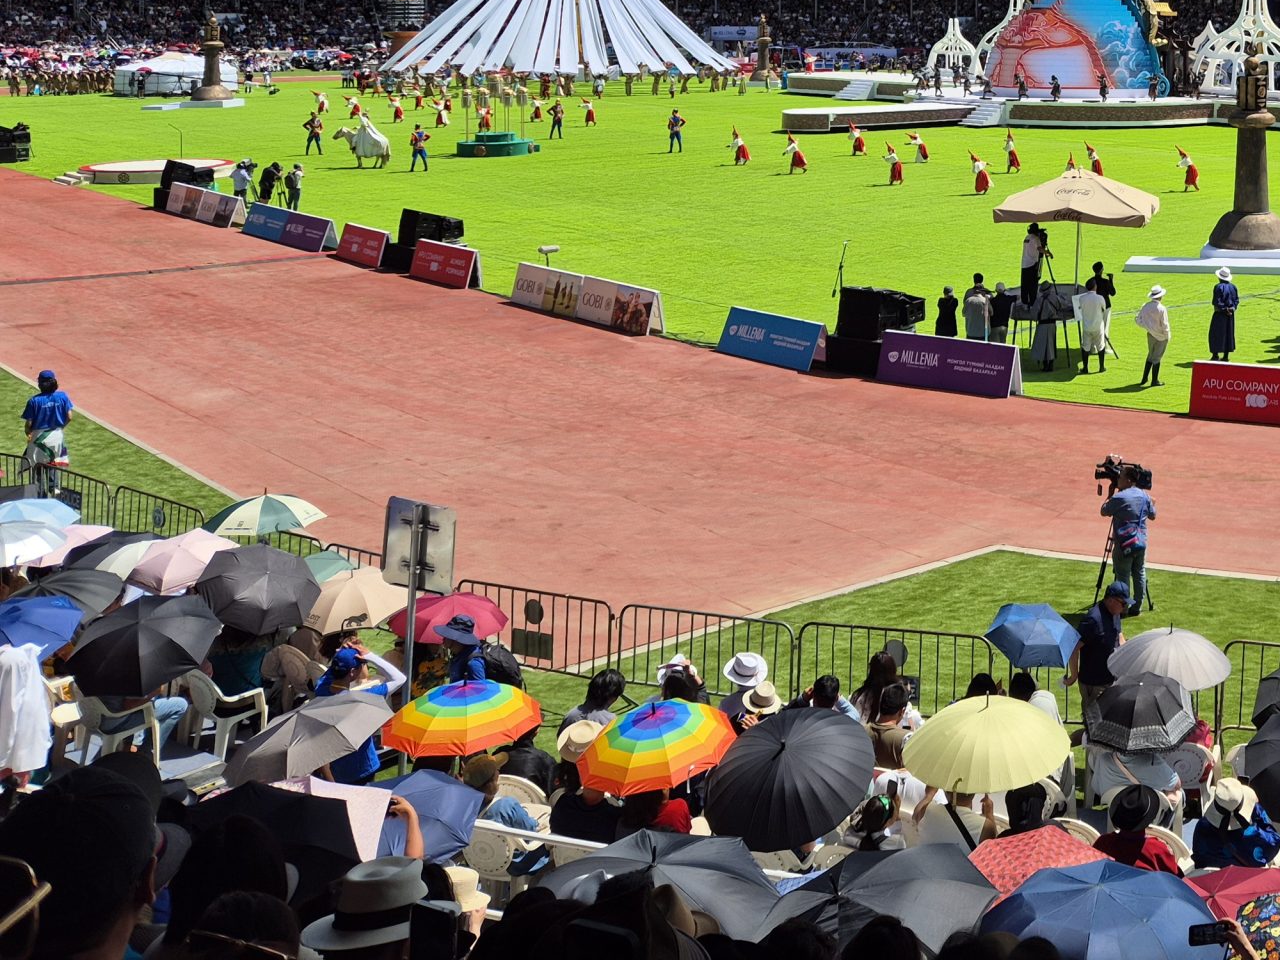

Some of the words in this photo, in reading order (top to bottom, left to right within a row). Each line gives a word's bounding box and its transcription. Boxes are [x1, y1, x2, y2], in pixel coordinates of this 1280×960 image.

[516, 277, 536, 294] GOBI
[582, 292, 604, 311] GOBI
[737, 324, 766, 342] MILLENIA
[900, 349, 939, 368] MILLENIA
[1202, 378, 1224, 389] APU
[1226, 379, 1280, 394] COMPANY
